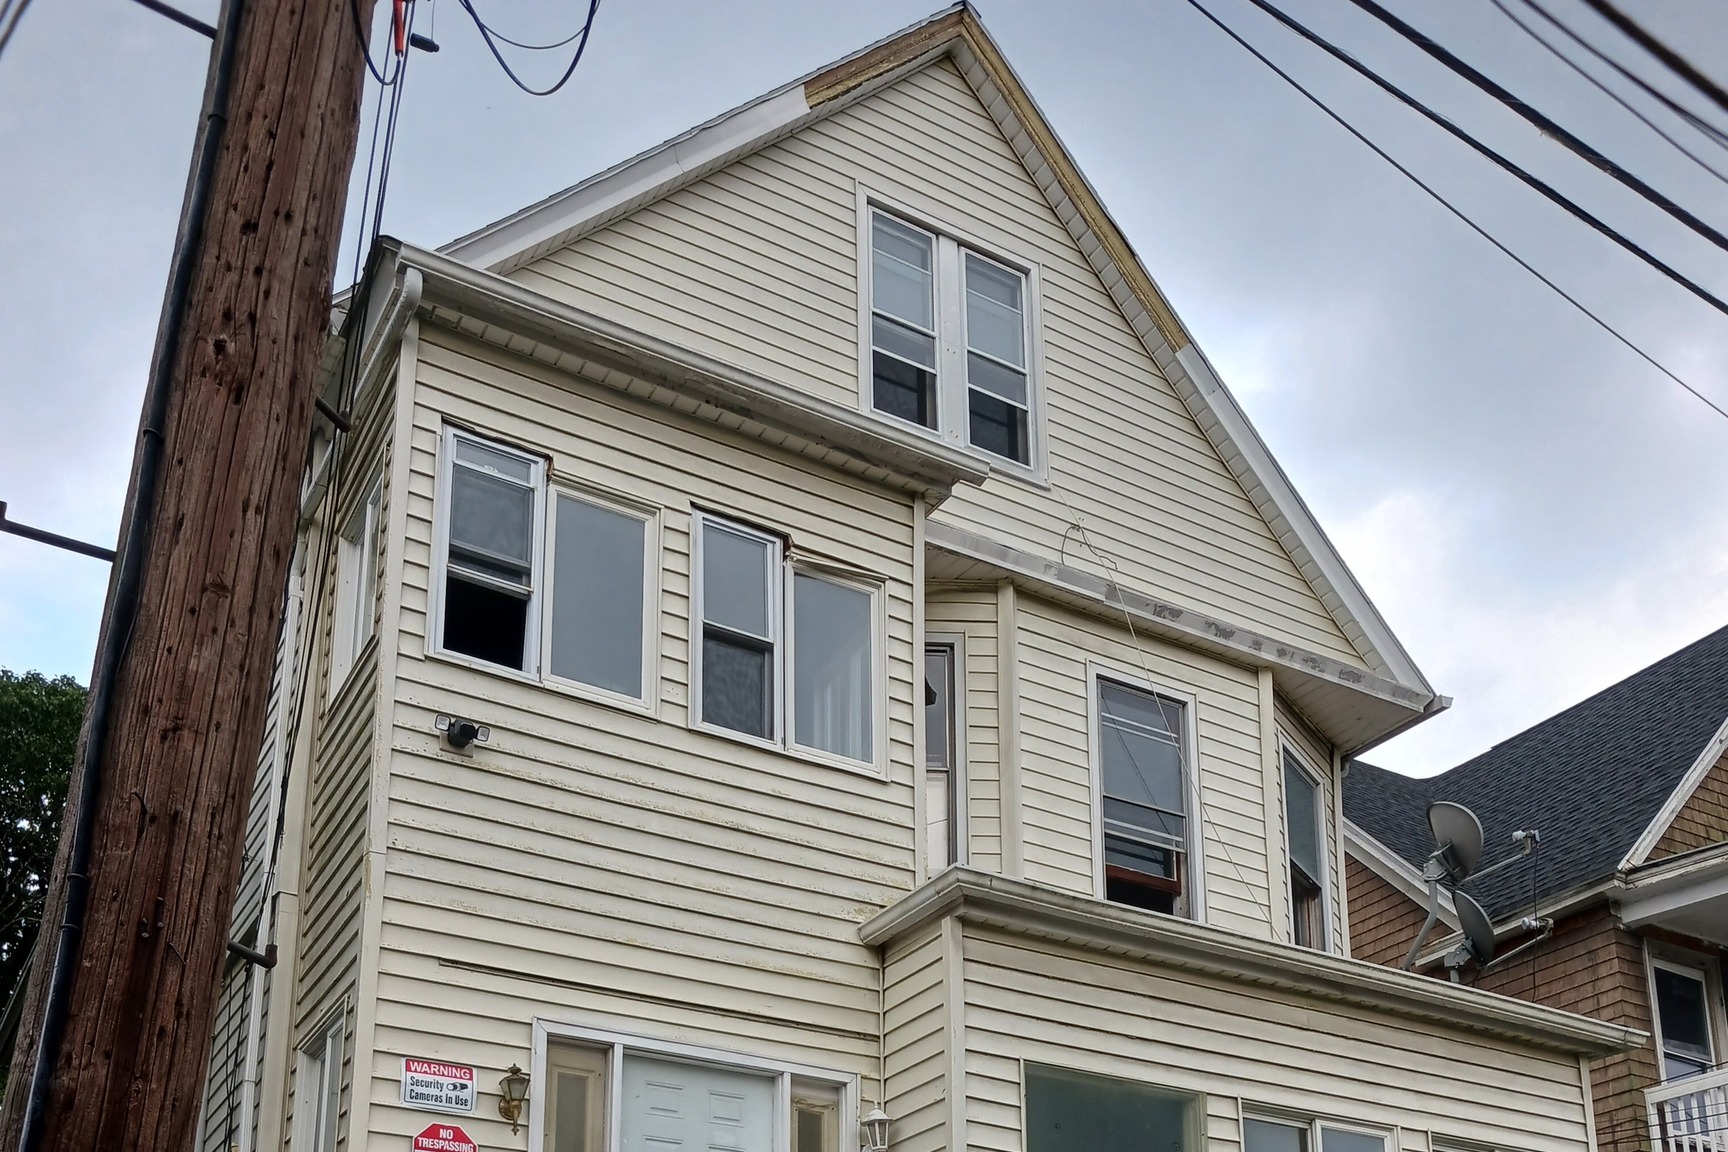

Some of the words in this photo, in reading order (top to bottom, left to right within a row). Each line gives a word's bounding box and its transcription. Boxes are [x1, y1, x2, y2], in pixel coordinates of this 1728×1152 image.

[409, 1061, 470, 1079] WARNING
[410, 1076, 444, 1092] Security
[409, 1089, 443, 1103] Cameras
[445, 1093, 453, 1104] In
[455, 1095, 469, 1107] Use
[439, 1128, 453, 1139] NO
[417, 1137, 474, 1152] TRESPASSING
